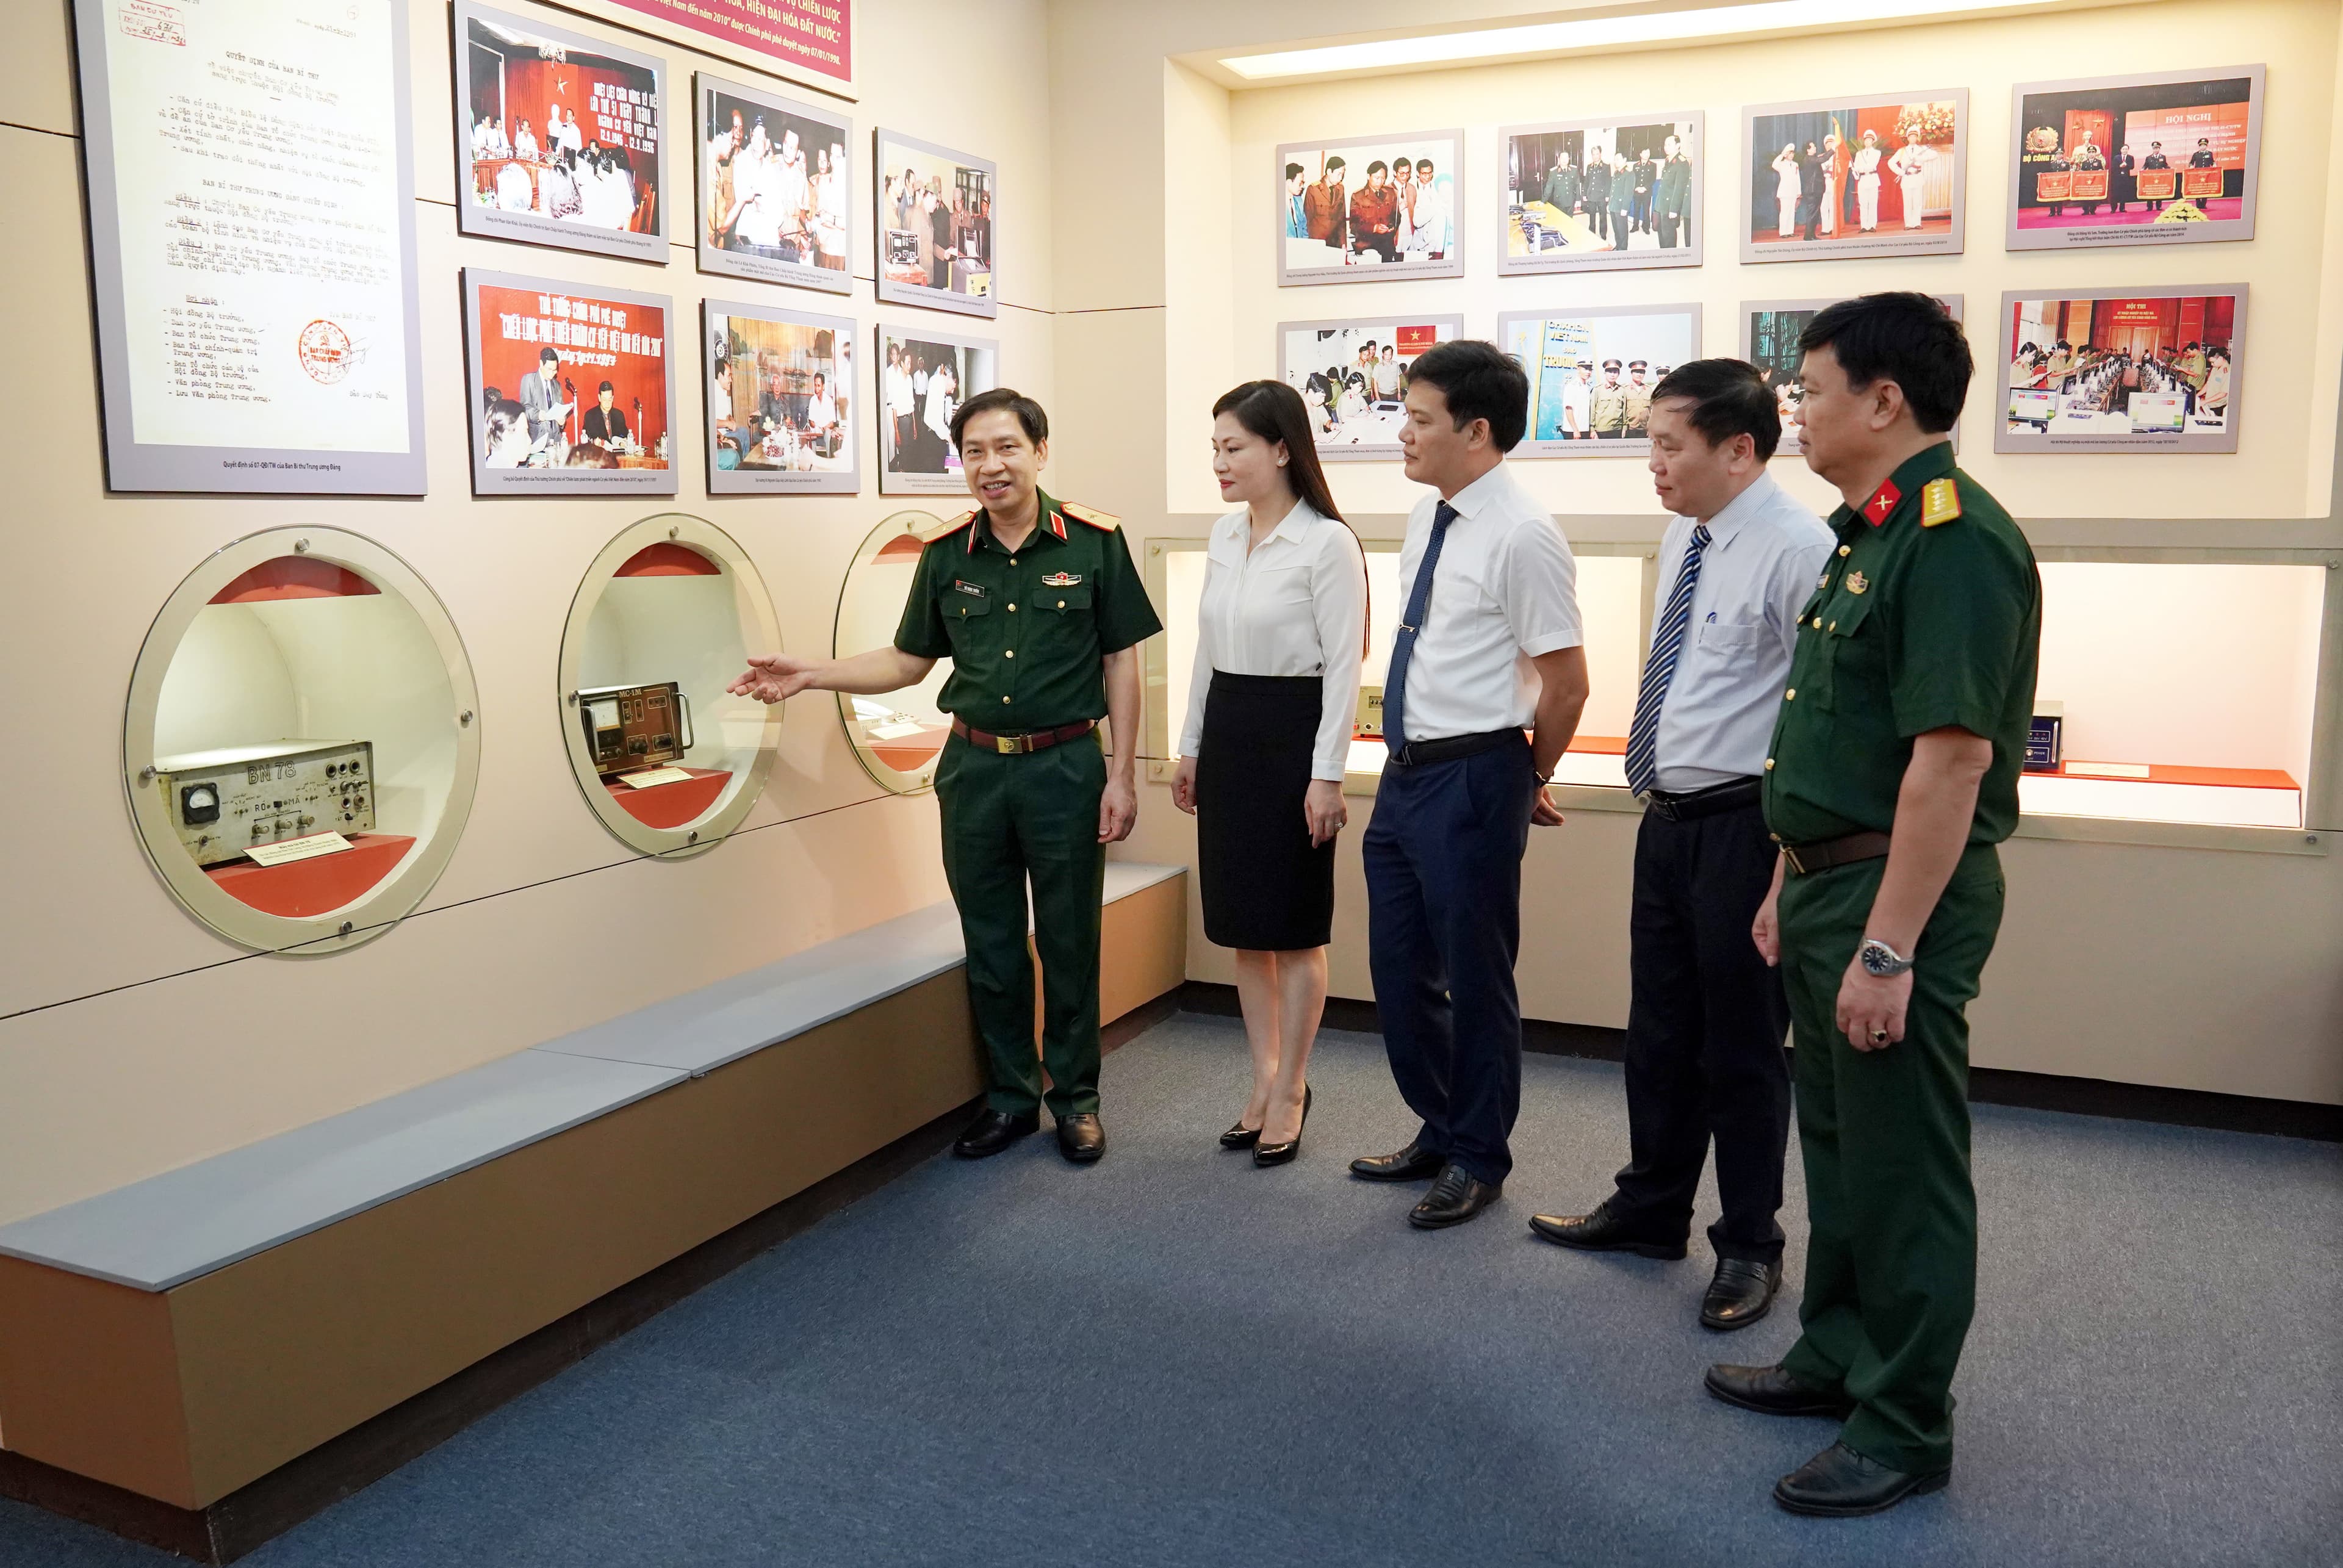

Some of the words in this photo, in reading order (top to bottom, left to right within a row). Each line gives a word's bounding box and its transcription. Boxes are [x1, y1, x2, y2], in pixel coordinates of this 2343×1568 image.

[746, 0, 766, 18] HIỆN
[767, 7, 781, 25] ĐẠI
[782, 12, 799, 30] HÓA
[799, 18, 815, 35] ĐẤT
[822, 5, 841, 25] LƯỢC
[672, 1, 687, 12] Nam
[687, 3, 699, 15] đến
[699, 8, 713, 21] năm
[713, 12, 731, 26] 2010"
[730, 18, 744, 33] được
[744, 23, 761, 37] Chính
[760, 29, 772, 41] phủ
[771, 34, 782, 45] phê
[782, 36, 797, 52] duyệt
[797, 43, 811, 56] ngày
[810, 47, 841, 65] 07/01/1998.
[2165, 115, 2184, 124] HỘI
[2186, 112, 2212, 123] NGHỊ
[2023, 154, 2032, 164] BỘ
[170, 307, 183, 316] Hội
[187, 309, 204, 318] đồng
[2126, 302, 2136, 311] HỘI
[200, 332, 217, 340] chức
[220, 334, 239, 344] Trung
[173, 349, 195, 359] Trung
[202, 362, 218, 370] chức
[175, 378, 189, 387] Văn
[191, 379, 212, 389] phòng
[215, 382, 235, 392] Trung
[191, 390, 205, 399] Văn
[207, 390, 228, 401] phòng
[231, 394, 250, 403] Trung
[222, 460, 237, 470] Quyết
[237, 461, 248, 469] định
[331, 464, 342, 472] Đảng
[618, 688, 642, 699] MC-1M
[247, 764, 272, 785] BN
[275, 760, 297, 780] 78
